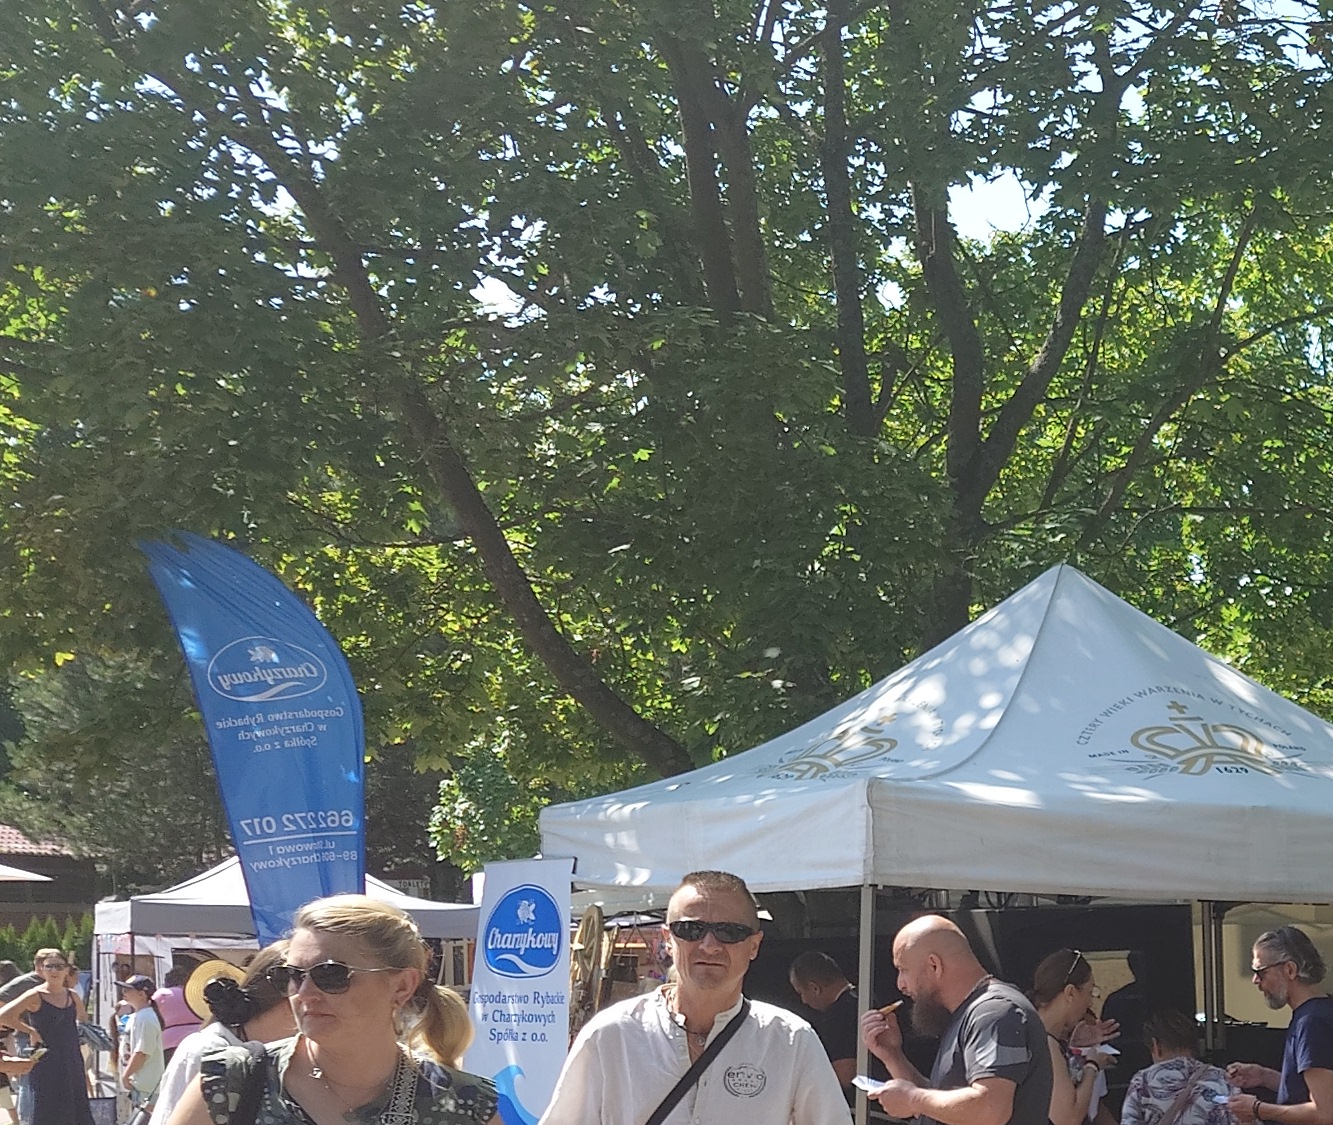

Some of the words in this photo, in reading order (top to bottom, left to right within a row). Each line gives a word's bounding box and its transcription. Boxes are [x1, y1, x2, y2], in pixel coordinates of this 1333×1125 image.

[1076, 717, 1104, 746] CZTERY
[1099, 696, 1135, 718] WIEKI
[1133, 685, 1206, 701] WARZENIA
[1209, 697, 1223, 706] W
[1229, 704, 1293, 737] TYCHACH
[1215, 766, 1249, 774] 1629
[531, 1032, 549, 1042] o.o.
